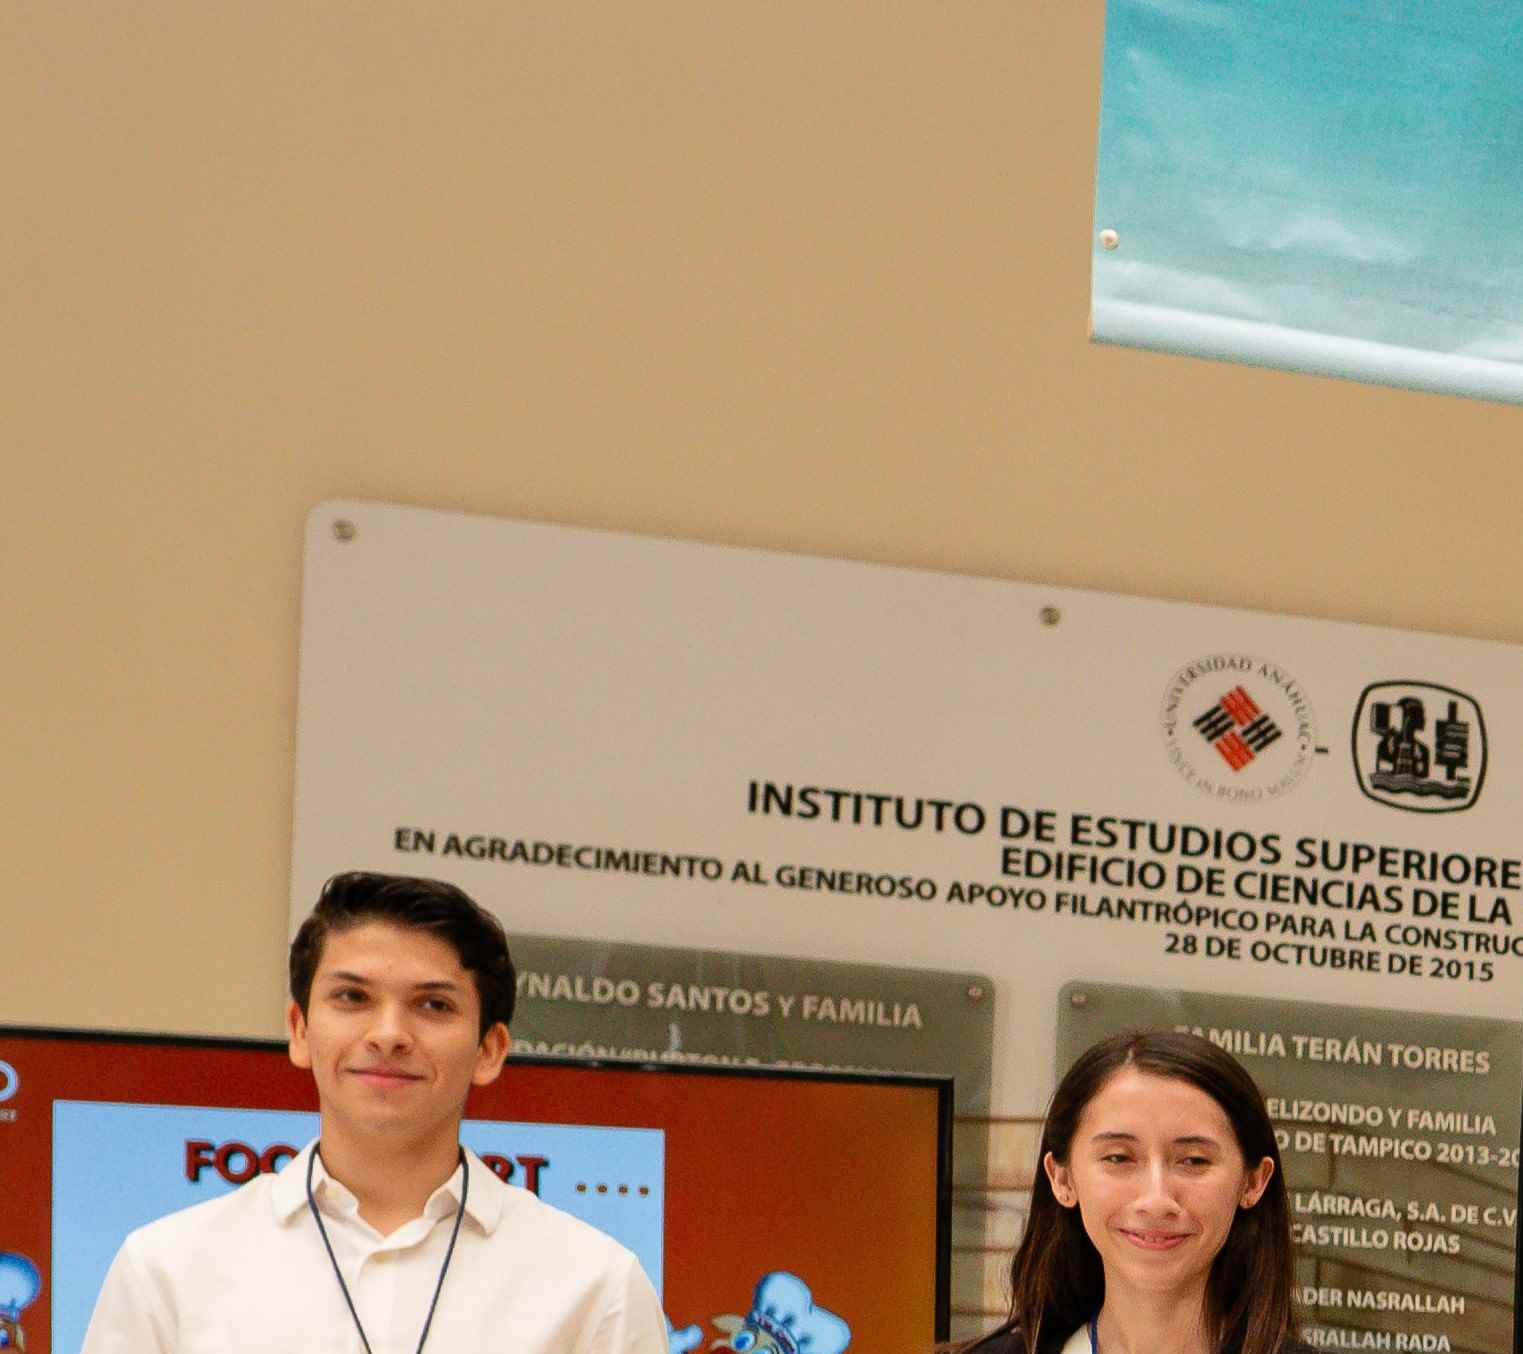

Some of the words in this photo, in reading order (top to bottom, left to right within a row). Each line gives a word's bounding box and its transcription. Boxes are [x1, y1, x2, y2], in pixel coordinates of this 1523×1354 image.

[746, 779, 986, 835] INSTITUTO
[1000, 806, 1056, 842] DE
[1070, 813, 1283, 866] ESTUDIOS
[394, 827, 435, 853] EN
[442, 833, 723, 881] AGRADECIMIENTO
[730, 861, 768, 886] AL
[775, 865, 937, 901] GENEROSO
[946, 881, 1046, 913] APOYO
[1055, 891, 1258, 932] FILANTRÓPICO
[1265, 913, 1336, 940] PARA
[1345, 919, 1377, 943] LA
[1001, 847, 1166, 890] EDIFICIO
[1176, 865, 1226, 898] DE
[1233, 871, 1404, 915] CIENCIAS
[1413, 887, 1460, 920] DE
[1469, 894, 1513, 926] LA
[1165, 933, 1198, 955] 28
[1206, 936, 1241, 960] DE
[1250, 941, 1380, 971] OCTUBRE
[1388, 954, 1423, 976] DE
[1430, 957, 1494, 982] 2015
[516, 970, 640, 1008] YNALDO
[646, 982, 769, 1018] SANTOS
[778, 996, 795, 1018] Y
[804, 996, 923, 1030] FAMILIA
[1292, 1033, 1382, 1066] TERÁN
[1388, 1044, 1491, 1075] TORRES
[1266, 1099, 1383, 1128] ELIZONDO
[1387, 1108, 1403, 1129] Y
[1407, 1109, 1497, 1137] FAMILIA
[1296, 1133, 1325, 1152] DE
[1329, 1134, 1433, 1162] TAMPICO
[1436, 1143, 1519, 1169] 2013-20
[1295, 1191, 1403, 1223] LÁRRAGA,
[1407, 1202, 1447, 1224] S.A.
[1451, 1206, 1479, 1225] DE
[1483, 1208, 1517, 1228] C.V
[1394, 1231, 1462, 1255] ROJAS
[1347, 1289, 1465, 1315] NASRALLAH
[1396, 1332, 1450, 1353] RADA
